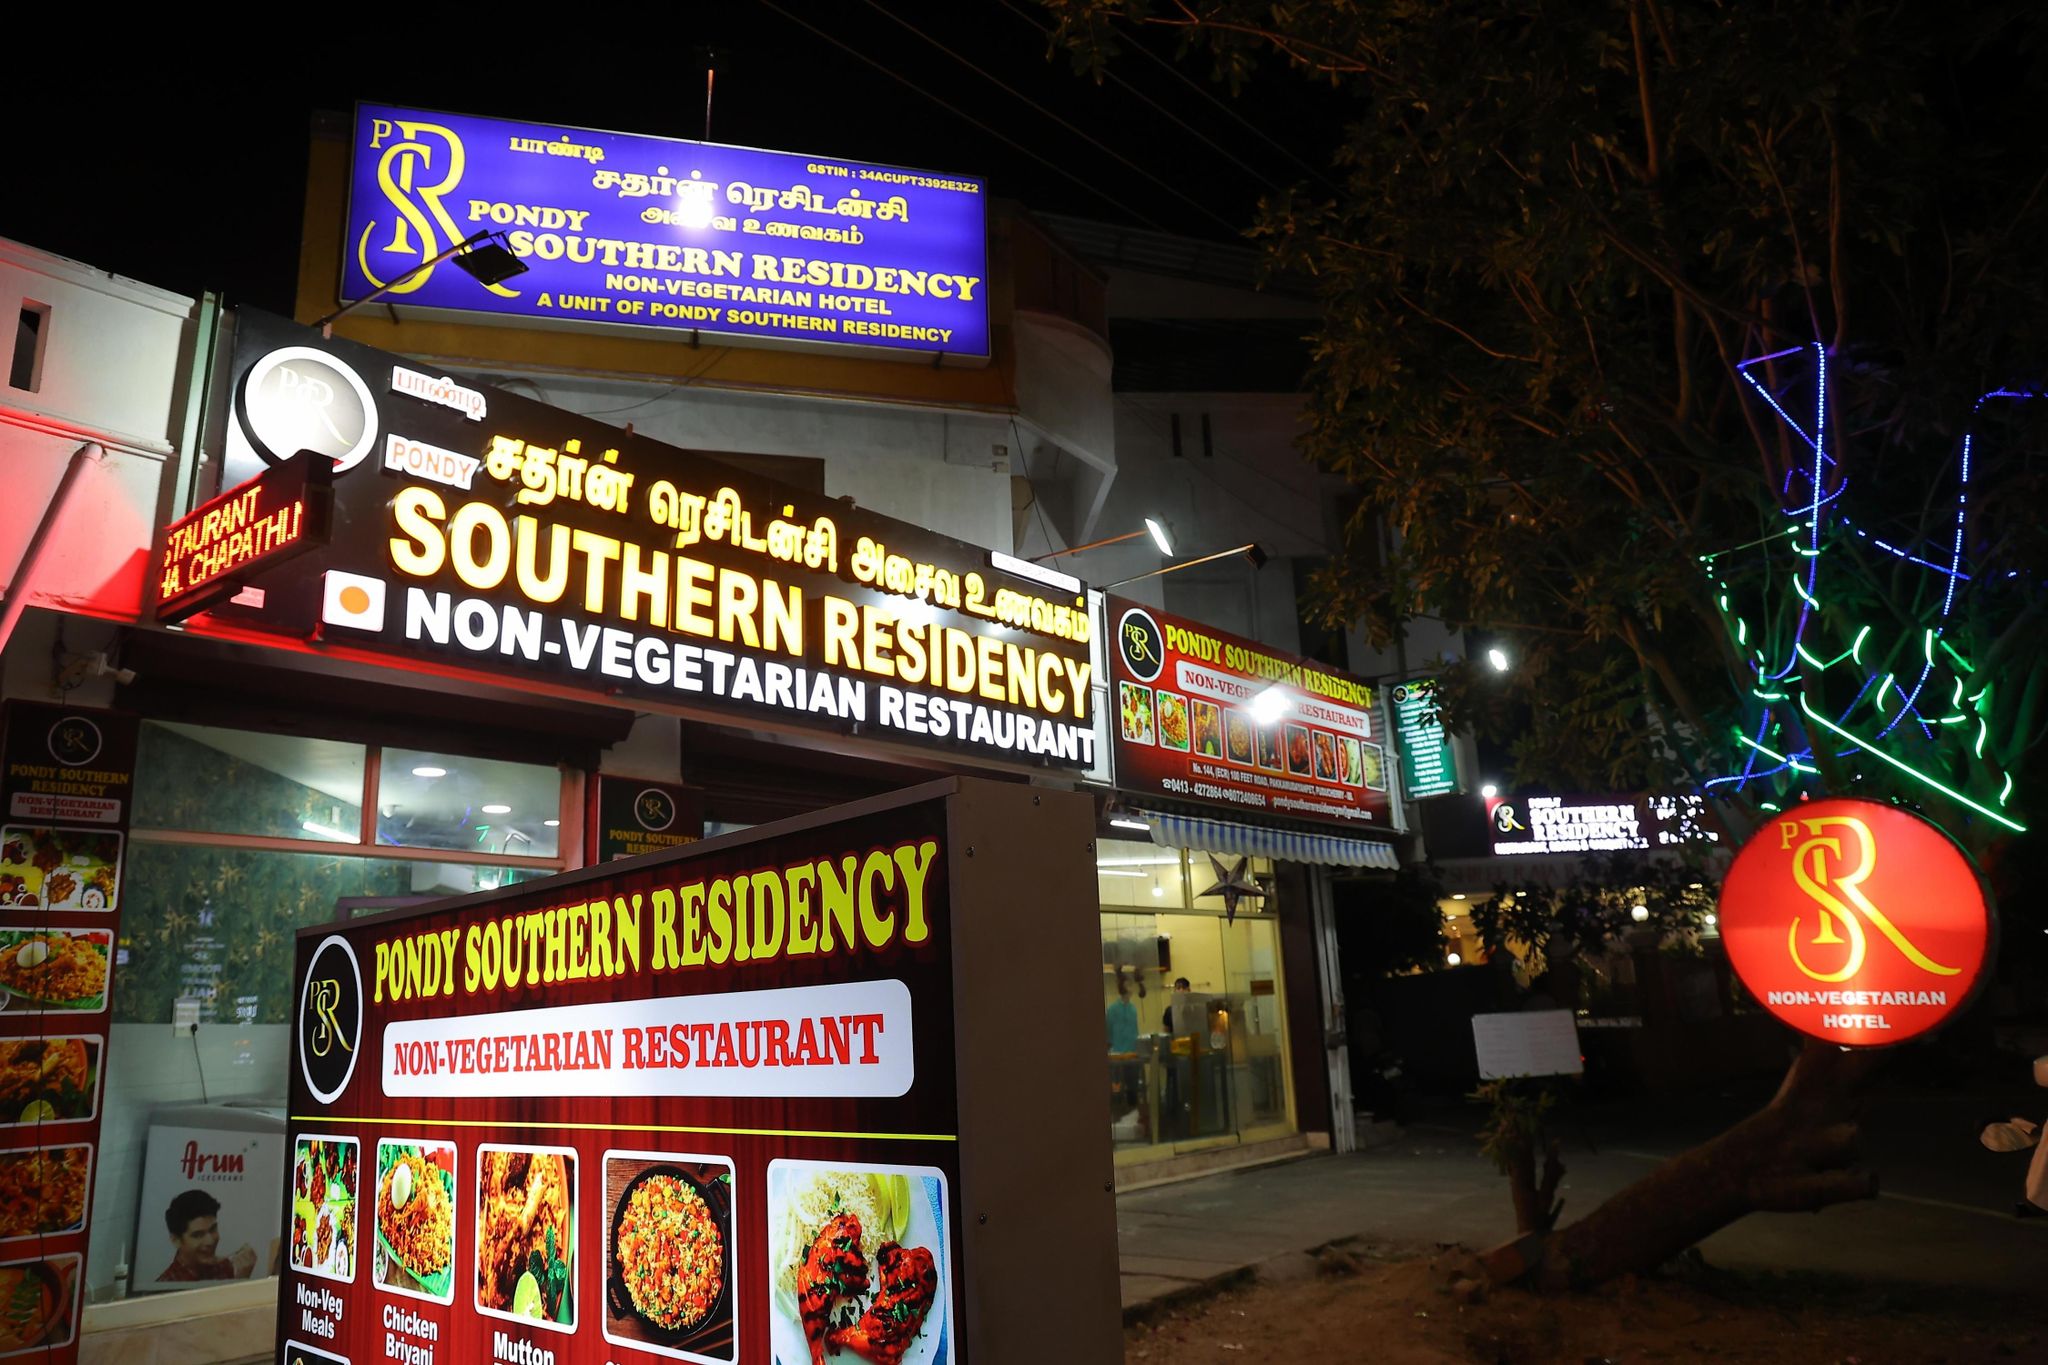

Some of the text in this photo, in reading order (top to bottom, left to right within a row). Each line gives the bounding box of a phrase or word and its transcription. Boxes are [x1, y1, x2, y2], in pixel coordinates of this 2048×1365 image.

[509, 136, 606, 165] பாண்டி
[806, 163, 849, 178] GSTIN
[468, 199, 591, 232] PONDY
[726, 181, 910, 223] ரெசிடன்சி
[742, 217, 865, 246] உணவகம்
[508, 229, 980, 301] SOUTHERN RESIDENCY
[605, 273, 893, 316] NON-VEGETARIAN HOTEL
[536, 292, 953, 344] A UNIT OF PONDY SOUTHERN RESIDENCY
[392, 440, 474, 486] PONDY
[648, 479, 839, 574] ரெசிடன்சி
[388, 485, 1093, 719] SOUTHERN RESIDENCY
[404, 586, 1097, 765] NON-VEGETARIAN RESTAURANT
[1164, 623, 1222, 665] PONDY
[1224, 643, 1304, 688] SOUTHERN
[1304, 666, 1373, 708] RESIDENCY
[1298, 701, 1366, 731] RESTAURANT
[10, 763, 130, 785] PONDY SOUTHERN
[31, 779, 107, 797] RESIDENCY
[373, 838, 938, 1005] PONDY SOUTHERN RESIDENCY
[1767, 990, 1947, 1007] NON-VEGETARIAN
[1822, 1013, 1892, 1029] HOTEL
[393, 1013, 885, 1077] NON-VEGETARIAN RESTAURANT
[180, 1139, 245, 1181] Arun
[296, 1281, 345, 1320] Non-Veg
[301, 1309, 336, 1340] Meals
[382, 1304, 439, 1342] Chicken
[384, 1337, 434, 1365] Briyani
[493, 1330, 556, 1365] Mutton
